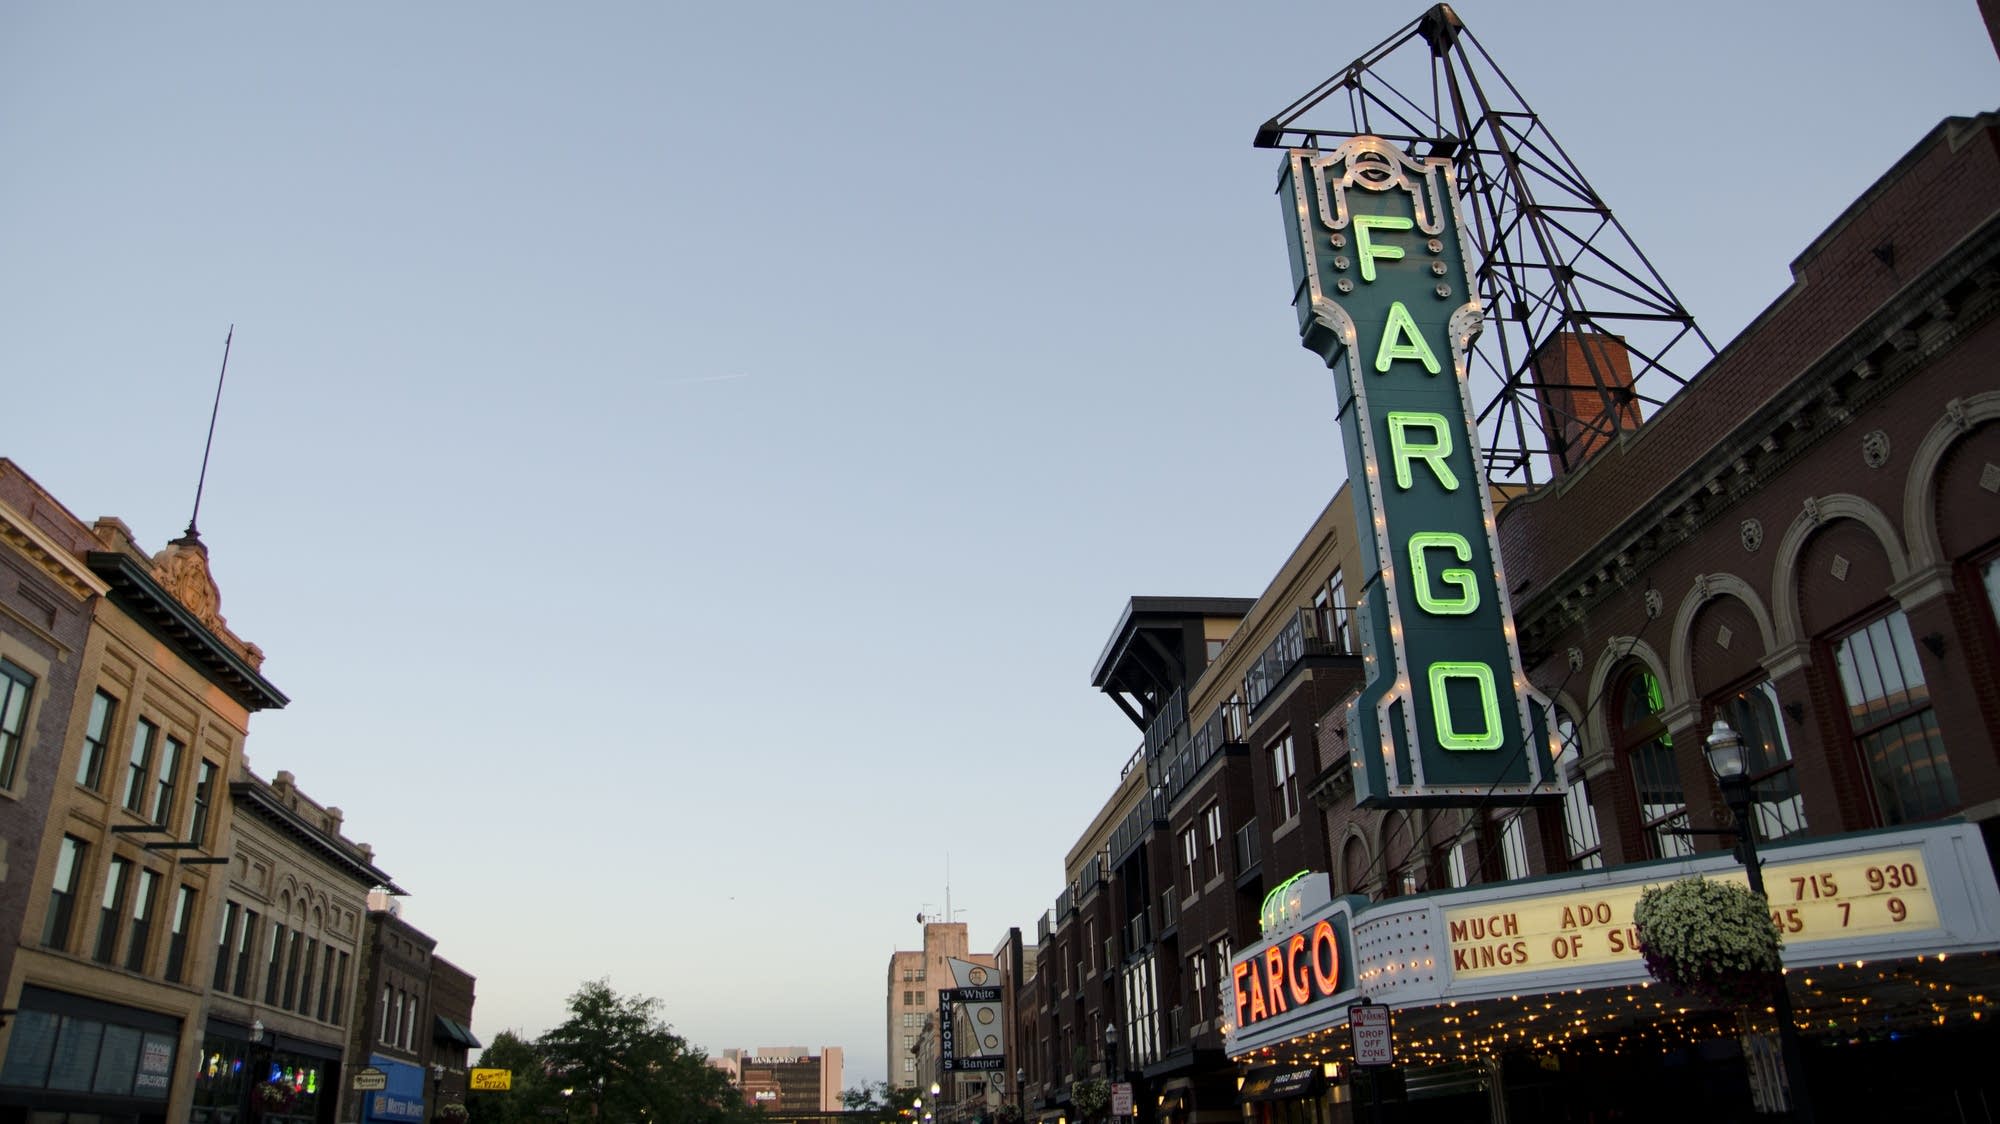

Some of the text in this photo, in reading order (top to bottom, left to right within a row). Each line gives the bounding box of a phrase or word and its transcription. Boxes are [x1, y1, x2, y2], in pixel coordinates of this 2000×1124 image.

[1353, 215, 1504, 750] FARGO
[1790, 863, 1918, 900] 715 930
[1450, 901, 1612, 942] MUCH ADO
[1837, 903, 1851, 927] 7
[1887, 897, 1907, 922] 9
[1453, 925, 1642, 971] KINGS OF SU
[1233, 920, 1339, 1027] FARGO
[963, 990, 994, 999] White
[942, 992, 953, 1069] UNIFORMS
[1352, 1012, 1363, 1022] NO
[1359, 1030, 1384, 1039] DROP
[1364, 1040, 1381, 1048] OFF
[961, 1059, 1001, 1069] Banner
[1361, 1048, 1386, 1057] ZONE
